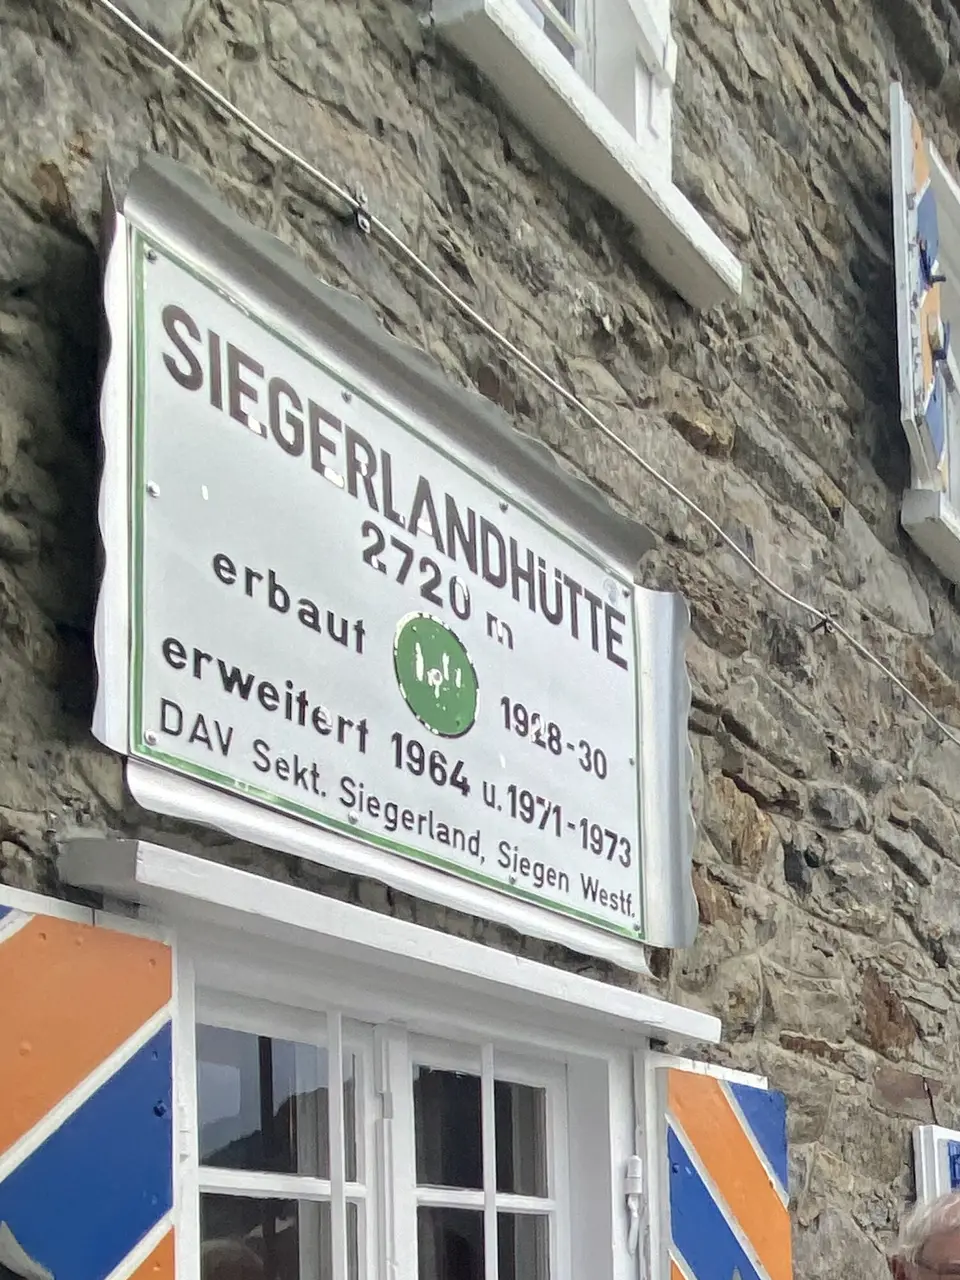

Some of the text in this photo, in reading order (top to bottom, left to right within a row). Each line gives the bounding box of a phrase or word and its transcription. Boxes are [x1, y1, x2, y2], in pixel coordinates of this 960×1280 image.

[161, 303, 628, 671] SIEGERLANDHÜTTE
[361, 520, 514, 650] 2720 m
[161, 636, 369, 754] erweitert
[391, 731, 471, 797] 1964
[212, 552, 608, 780] erbaut 1928-30
[160, 696, 636, 919] DAV Sekt. Siegerland, Siegen Westf.
